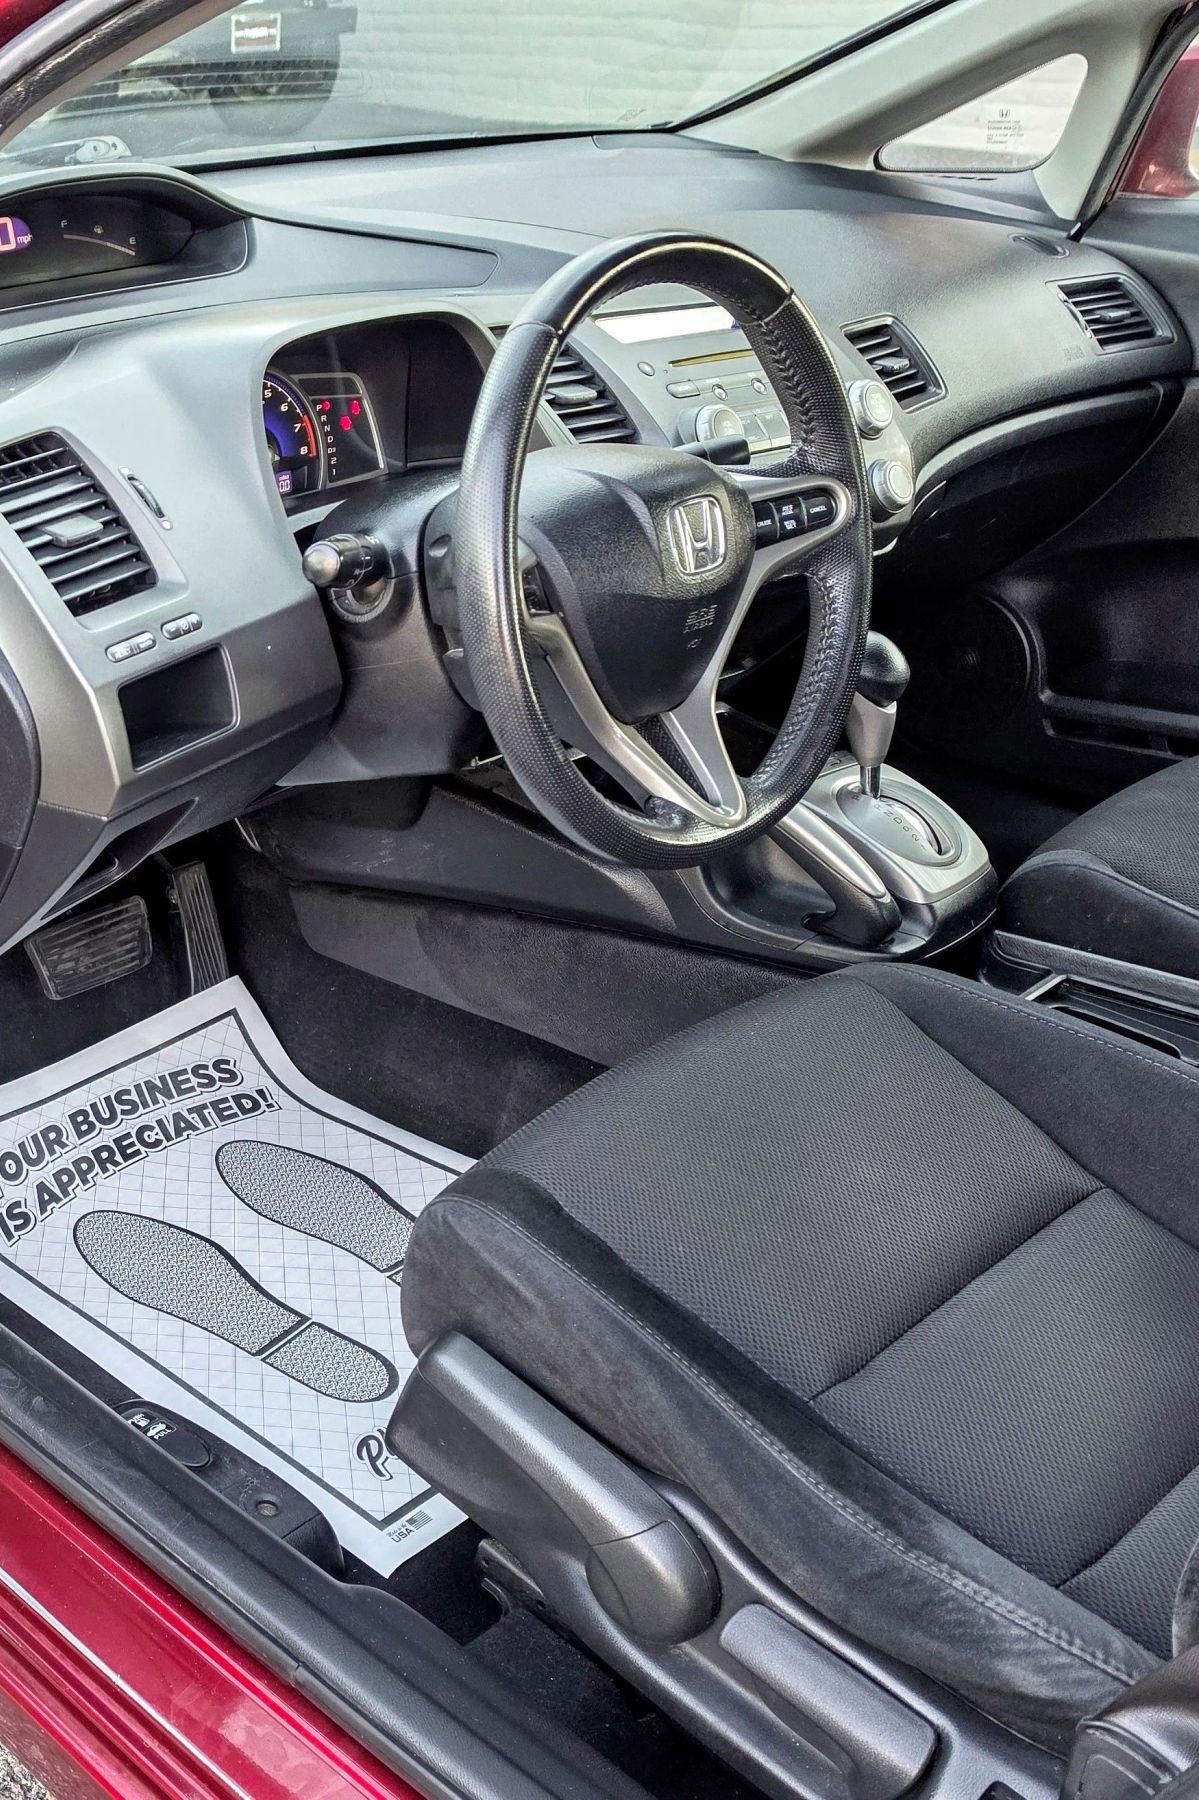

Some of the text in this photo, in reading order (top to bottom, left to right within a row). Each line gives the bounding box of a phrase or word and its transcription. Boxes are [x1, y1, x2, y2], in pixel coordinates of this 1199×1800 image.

[61, 219, 68, 229] F
[129, 236, 137, 245] E
[264, 389, 272, 398] 5
[280, 403, 289, 412] 6
[316, 404, 322, 412] P
[293, 423, 301, 433] 7
[327, 435, 334, 443] D
[300, 446, 308, 455] 8
[68, 1058, 243, 1142] BUSINESS
[34, 1087, 281, 1221] APPRECIATED!
[153, 1428, 172, 1440] PULL
[391, 1527, 415, 1543] USA
